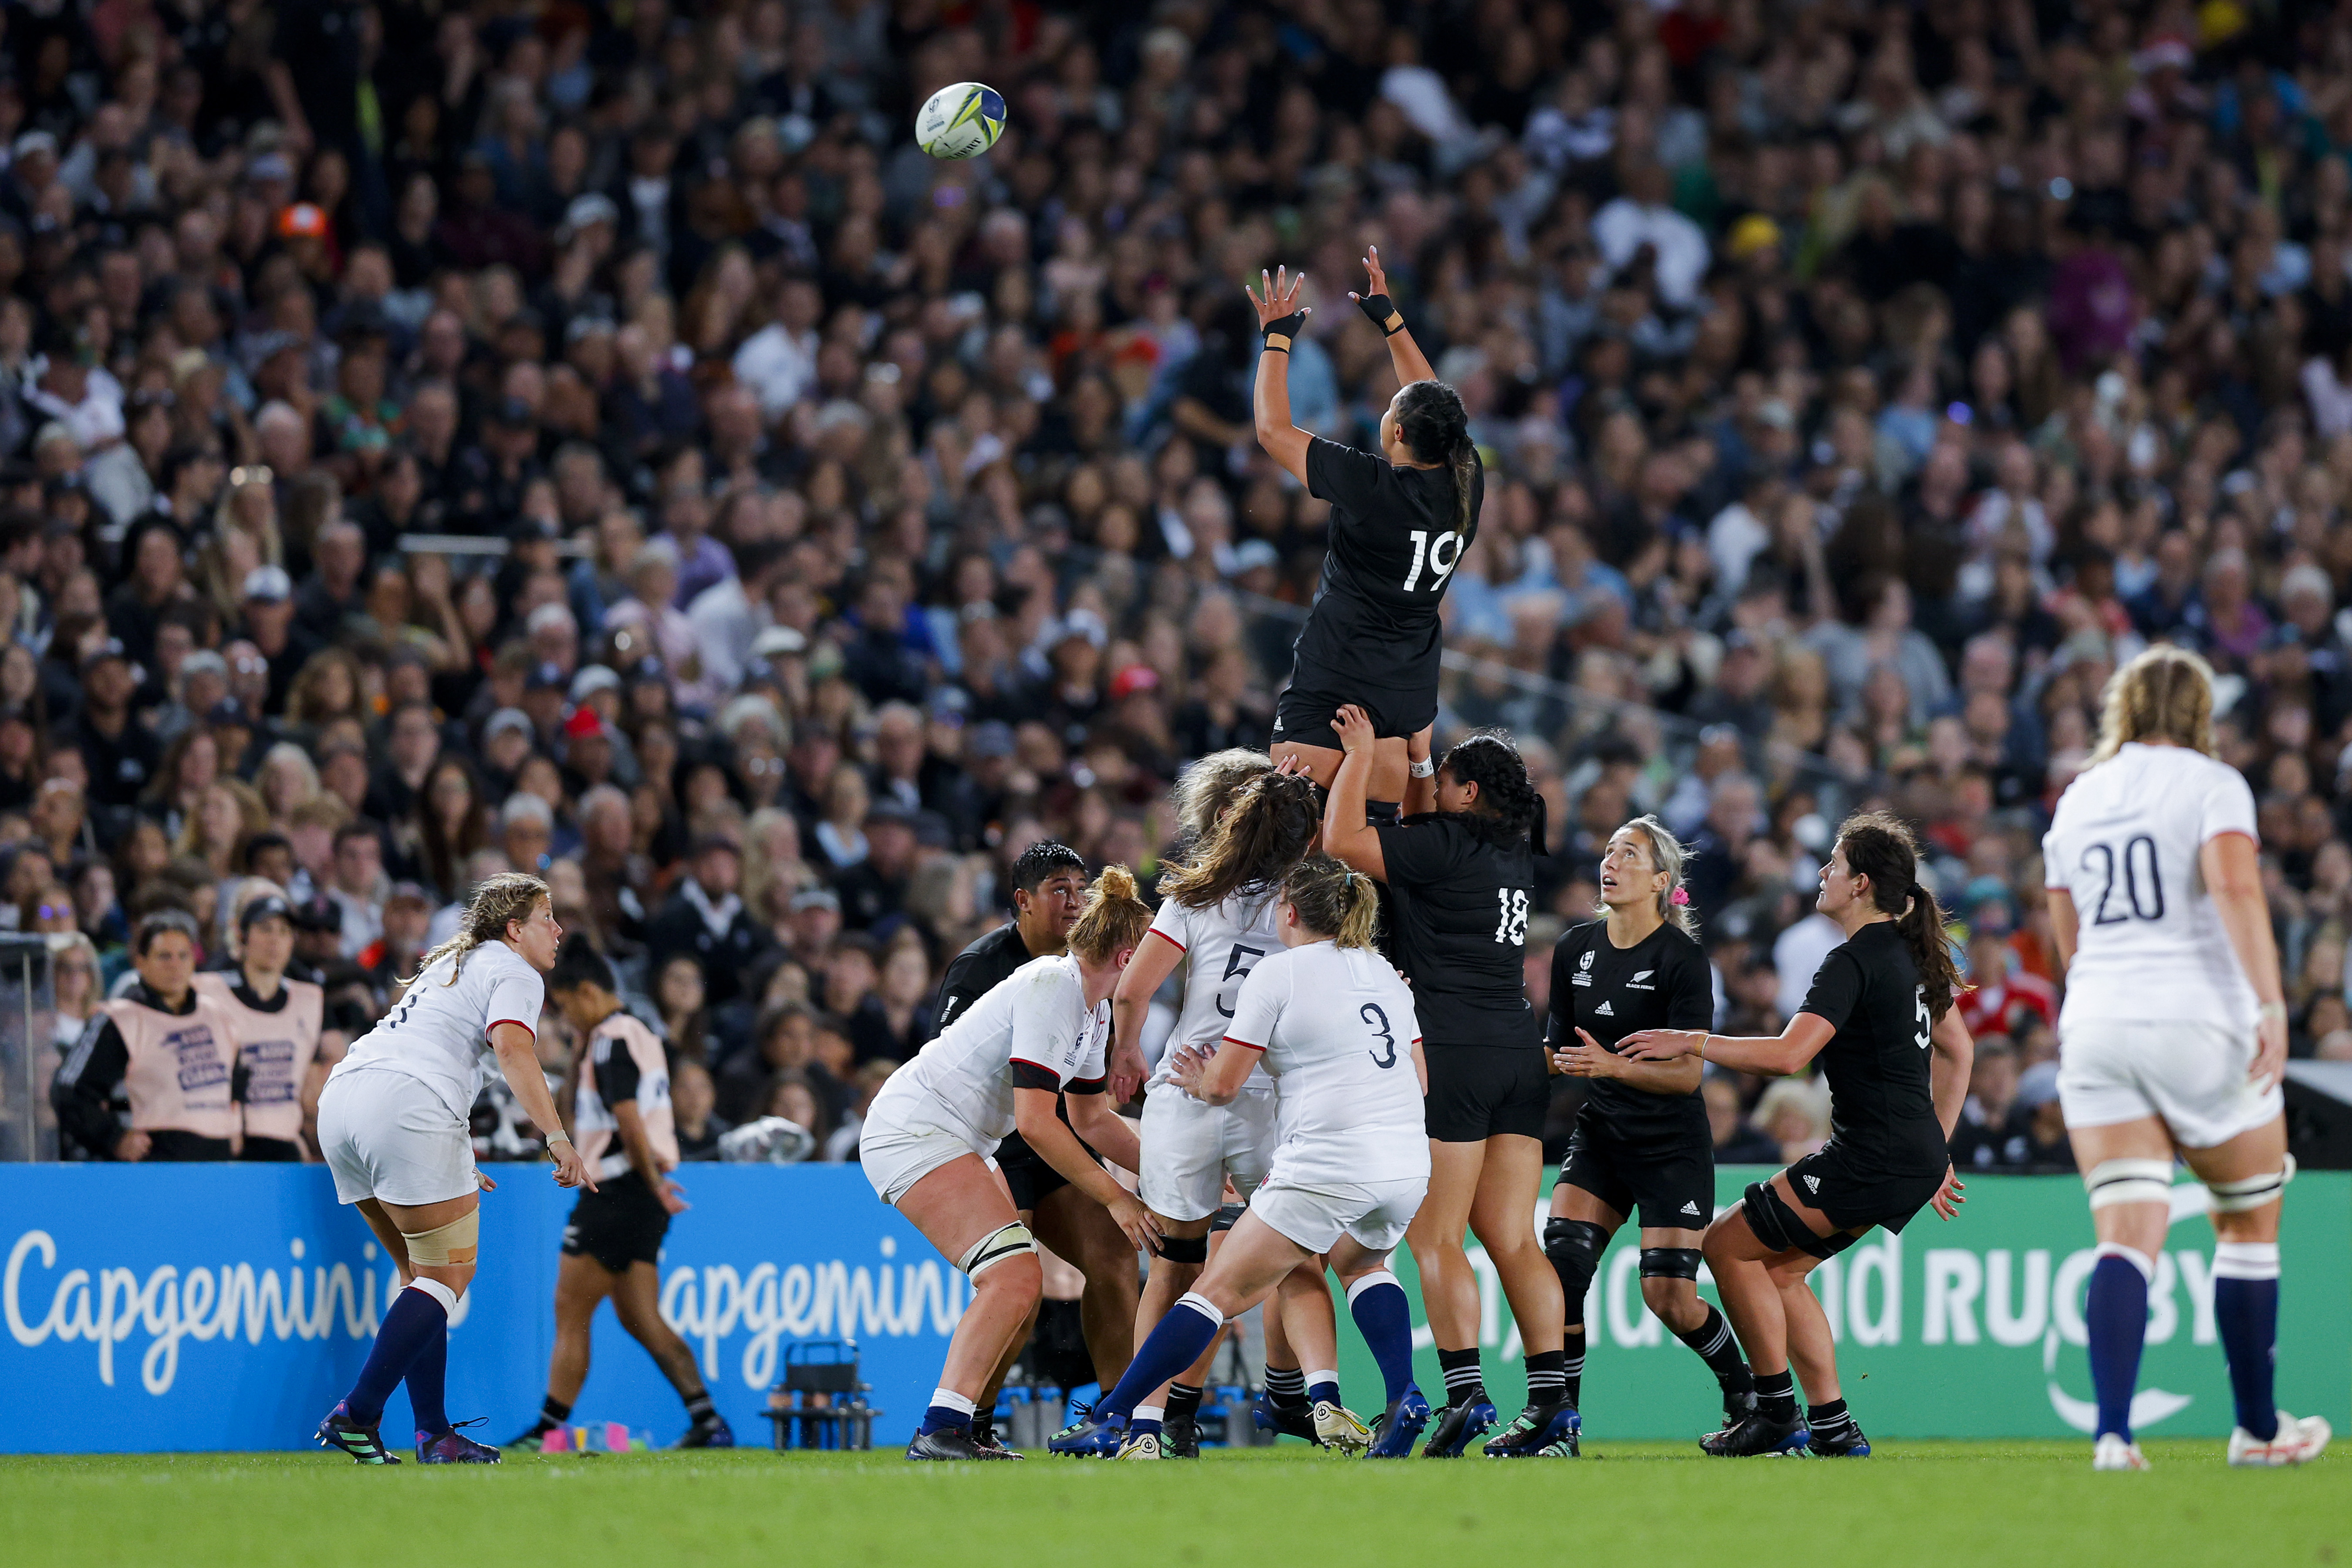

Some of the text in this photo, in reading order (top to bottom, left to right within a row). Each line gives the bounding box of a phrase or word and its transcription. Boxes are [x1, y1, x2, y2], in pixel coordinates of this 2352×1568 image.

[1403, 530, 1463, 591] 19
[2081, 833, 2164, 926] 20
[1495, 888, 1529, 946] 18
[1216, 943, 1266, 1019] 5
[1360, 1002, 1397, 1069] 3
[1914, 984, 1931, 1049] 5
[1803, 1175, 1818, 1195] adidas
[3, 1230, 380, 1396] Capgemini
[658, 1236, 964, 1389] apgemini
